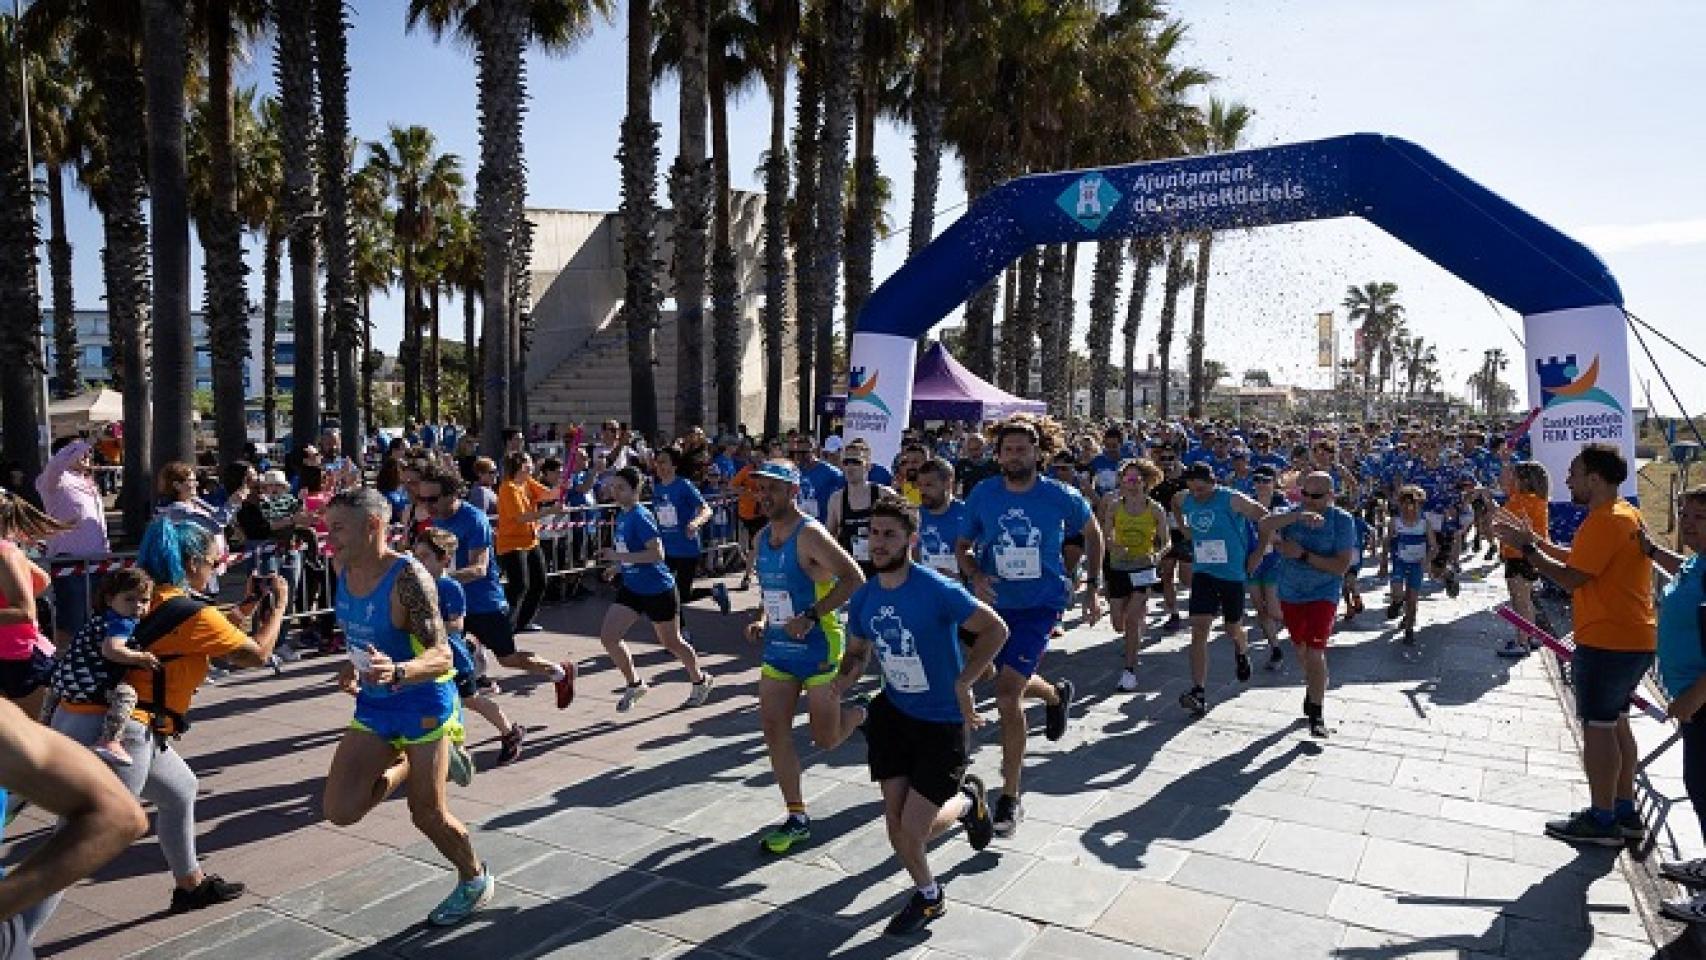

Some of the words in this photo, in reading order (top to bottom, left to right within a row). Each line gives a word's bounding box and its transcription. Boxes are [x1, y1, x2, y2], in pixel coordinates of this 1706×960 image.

[1133, 163, 1254, 193] Ajuntament
[1135, 196, 1157, 212] de
[1163, 178, 1304, 210] Castelldefels
[1542, 413, 1622, 428] Castelldefels
[1543, 429, 1568, 442] FEM
[1573, 425, 1622, 441] ESPORT
